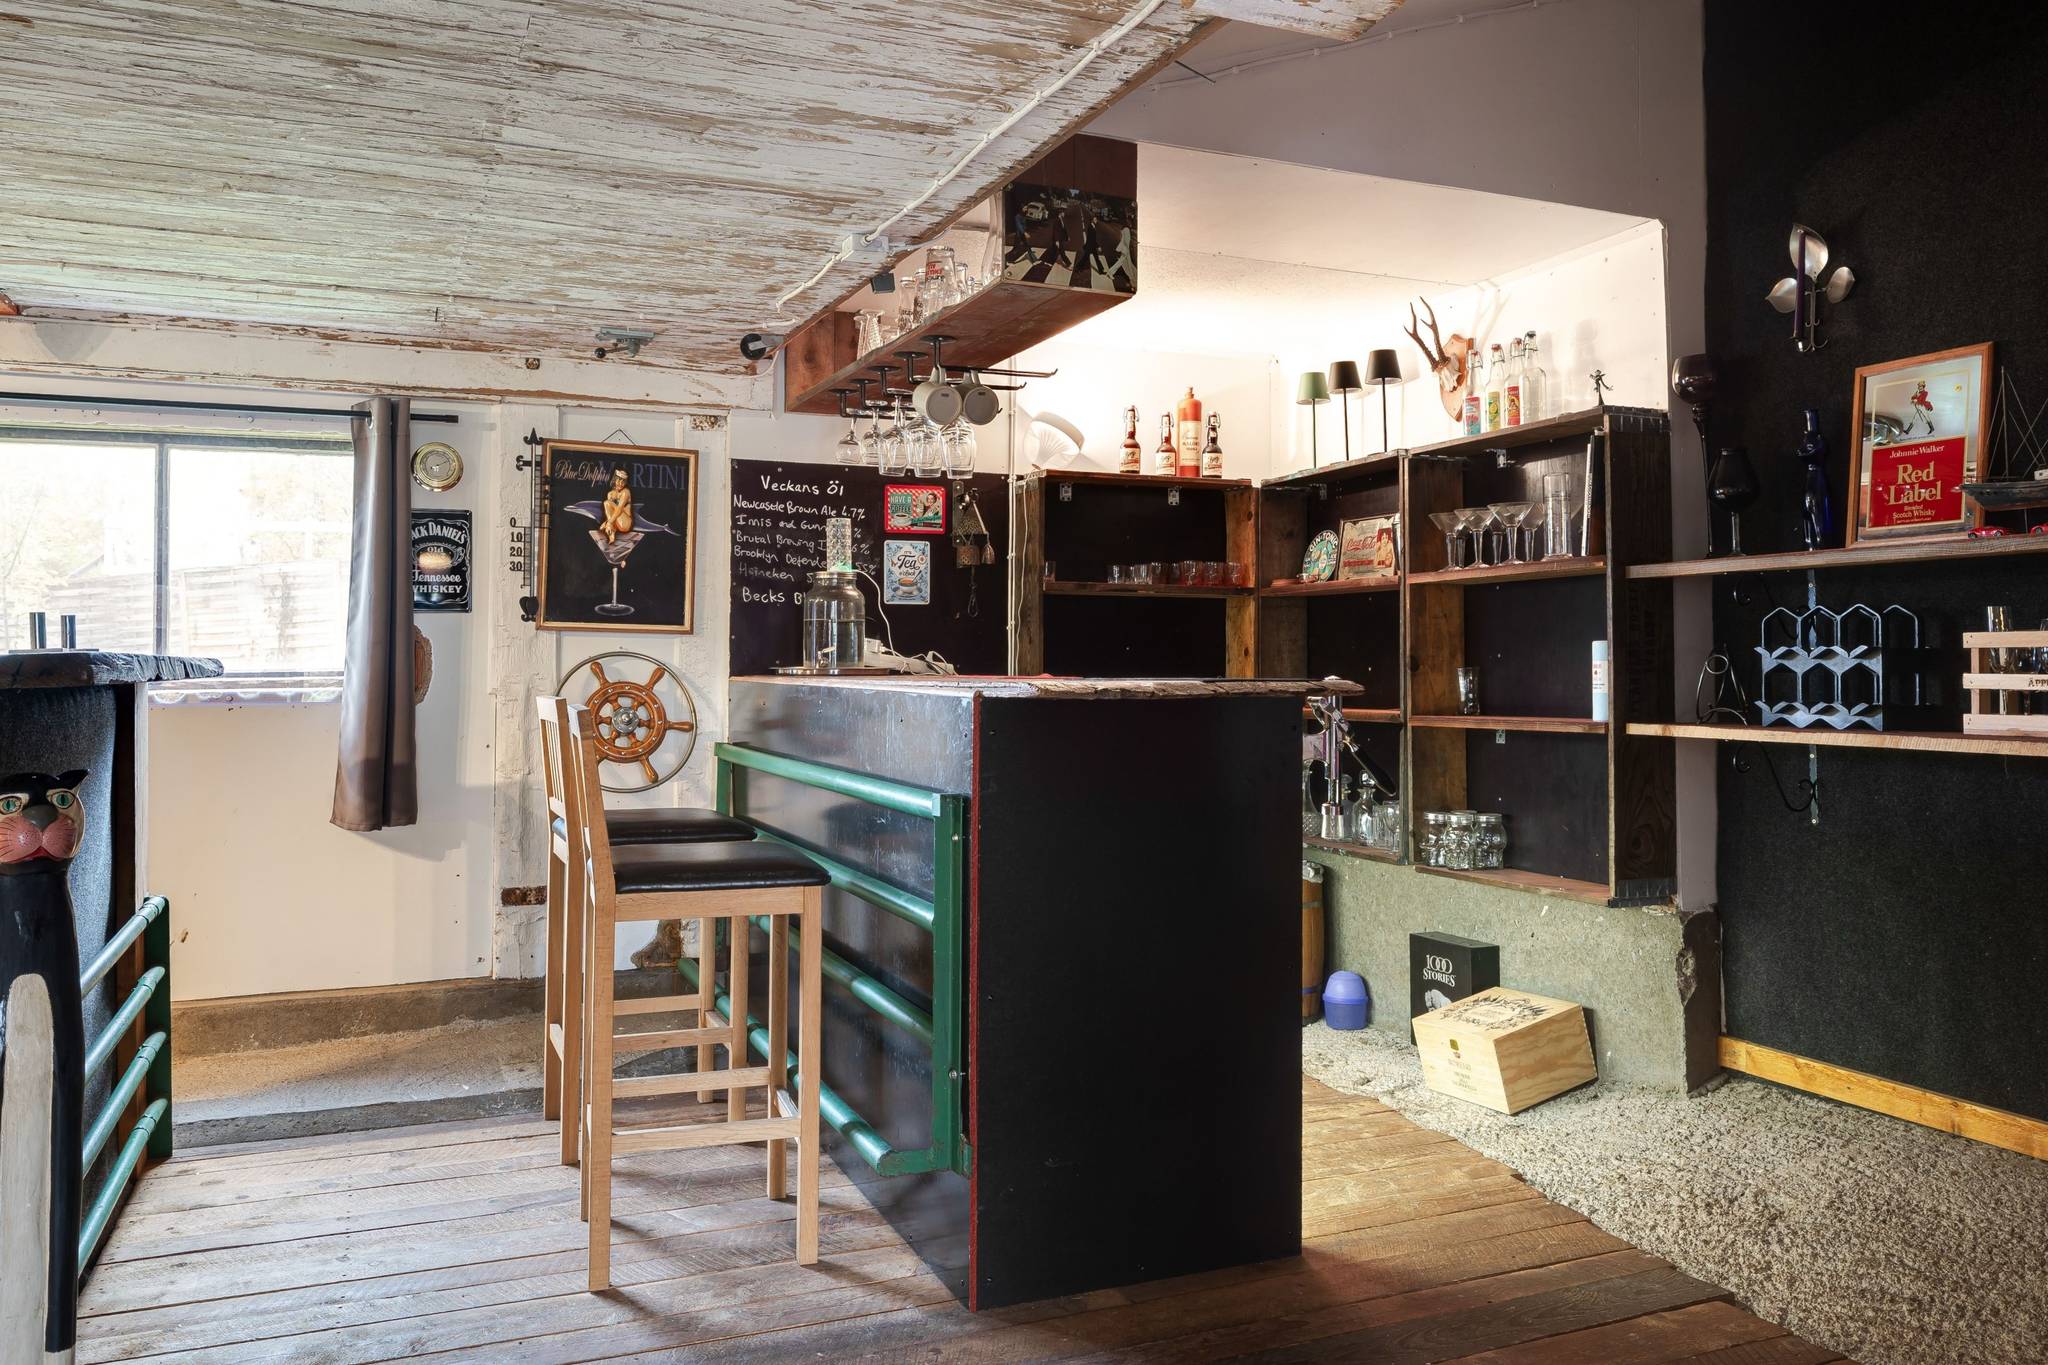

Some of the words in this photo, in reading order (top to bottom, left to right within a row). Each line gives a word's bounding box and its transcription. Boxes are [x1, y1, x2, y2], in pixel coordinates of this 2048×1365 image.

[1889, 449, 1919, 459] Johnnie
[1919, 445, 1945, 455] Walker
[555, 460, 577, 480] Blue
[597, 461, 686, 490] MRTINI
[1897, 461, 1935, 484] Red
[760, 475, 819, 495] Veckans
[1887, 480, 1942, 505] Label
[733, 494, 785, 513] Newcastle
[786, 500, 819, 515] Brown
[820, 505, 837, 517] Ale
[412, 526, 429, 540] ACK
[510, 532, 523, 542] 10
[736, 530, 771, 544] Brutal
[509, 546, 523, 557] 20
[509, 562, 523, 572] 30
[785, 553, 828, 568] Defende
[897, 555, 920, 570] Tea
[412, 569, 462, 583] Tennessee
[739, 562, 795, 582] Heineken
[742, 586, 785, 603] Becks
[1426, 955, 1453, 974] 1000
[1423, 968, 1456, 988] STORIES
